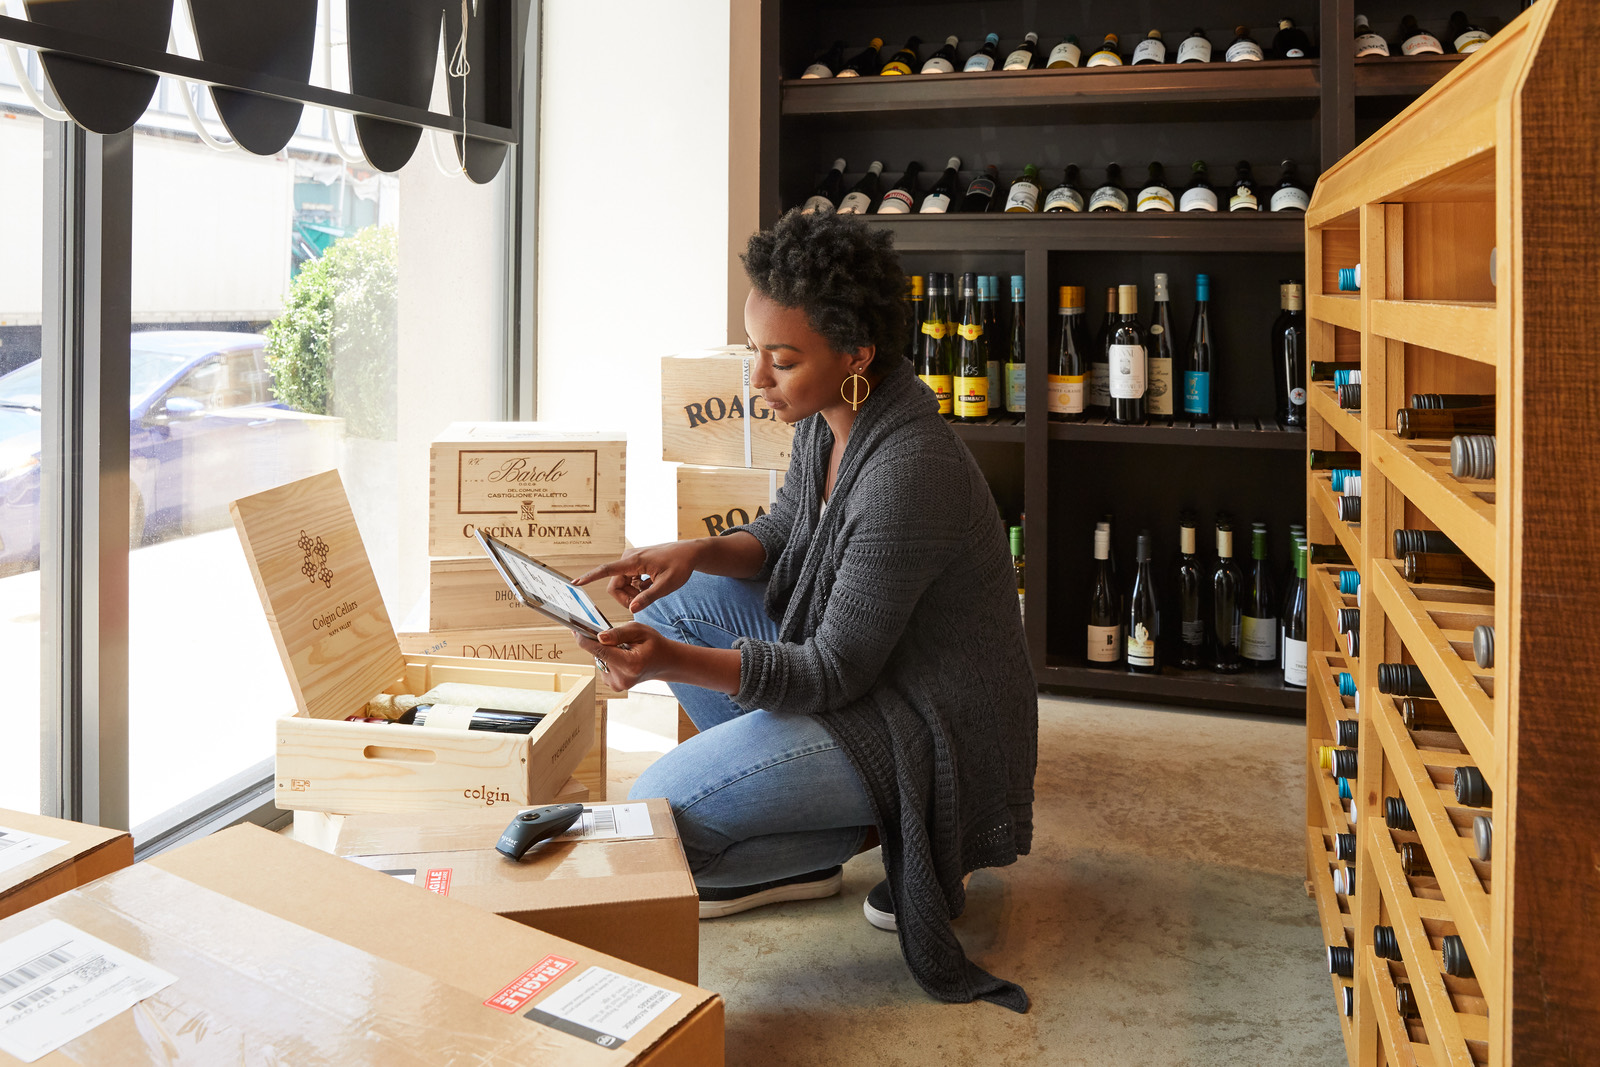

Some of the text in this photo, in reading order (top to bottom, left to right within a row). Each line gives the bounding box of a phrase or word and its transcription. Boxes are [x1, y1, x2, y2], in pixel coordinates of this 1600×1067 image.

[684, 394, 796, 429] ROAG
[487, 457, 568, 483] Barolo
[528, 524, 590, 538] FONTANA
[312, 601, 358, 630] Colgin Cellars
[328, 620, 352, 637] NAPA VALLEY
[1106, 634, 1113, 645] B
[462, 644, 563, 660] DOMAINE de
[464, 785, 510, 806] colgin
[492, 958, 554, 1004] HANDLE WITH CARE
[500, 960, 568, 1008] FRAGILE
